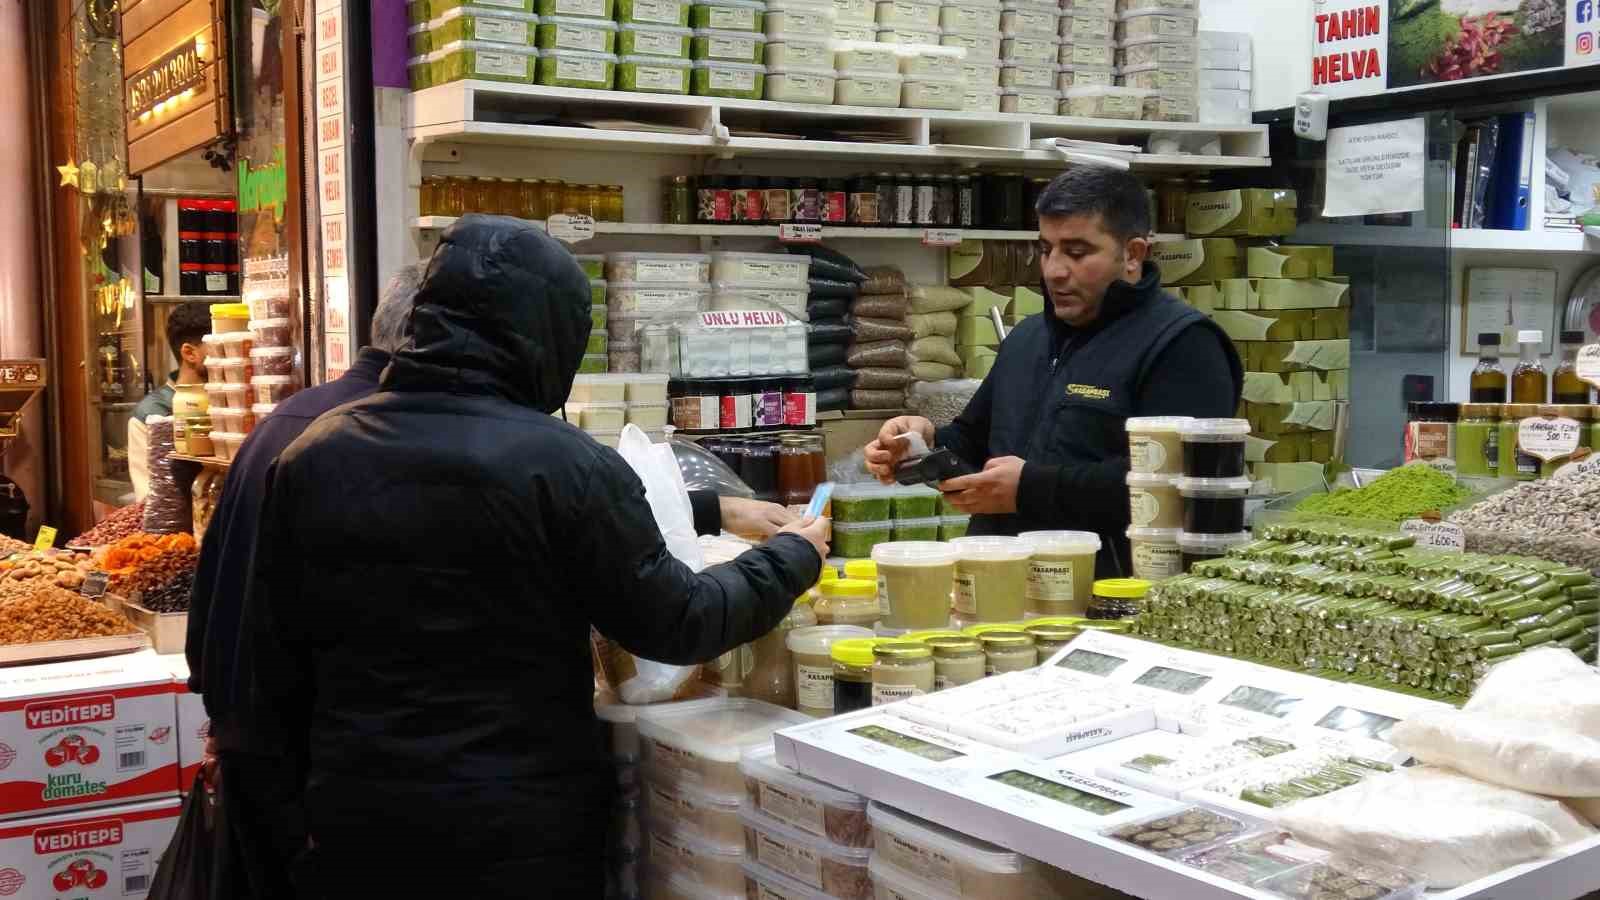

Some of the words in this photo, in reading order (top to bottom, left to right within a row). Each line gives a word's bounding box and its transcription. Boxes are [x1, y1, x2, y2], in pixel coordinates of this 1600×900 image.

[1315, 5, 1380, 43] TAHİN
[1313, 48, 1381, 85] HELVA
[743, 311, 785, 325] HELVA
[1546, 431, 1560, 441] 500
[1430, 534, 1450, 546] 1600
[28, 703, 113, 726] YEDİTEPE
[44, 781, 106, 800] domates
[47, 773, 81, 789] kuru
[36, 827, 120, 851] YEDİTEPE
